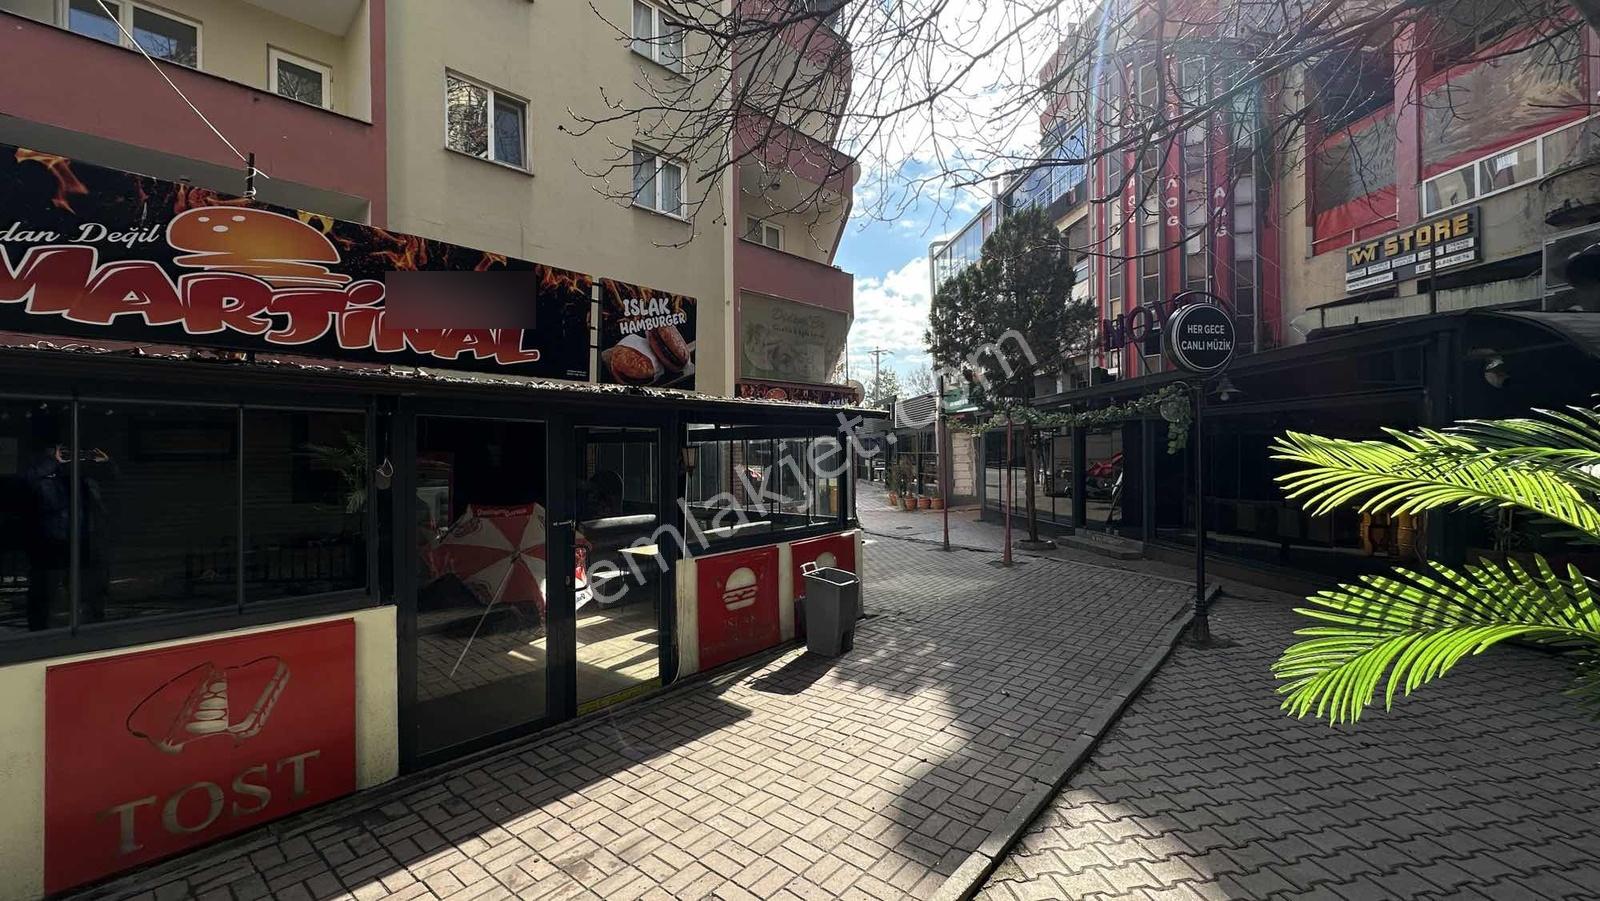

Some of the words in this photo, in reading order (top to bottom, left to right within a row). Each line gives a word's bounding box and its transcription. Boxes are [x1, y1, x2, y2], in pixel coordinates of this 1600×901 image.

[69, 223, 160, 249] Değil
[1385, 213, 1470, 257] STORE
[623, 298, 671, 317] ISLAK
[619, 313, 687, 335] HAMBURGER
[1187, 324, 1203, 334] HER
[1204, 324, 1225, 335] GECE
[1181, 340, 1205, 351] CANLI
[1206, 338, 1231, 351] MÜZİK
[98, 750, 321, 855] TOST
